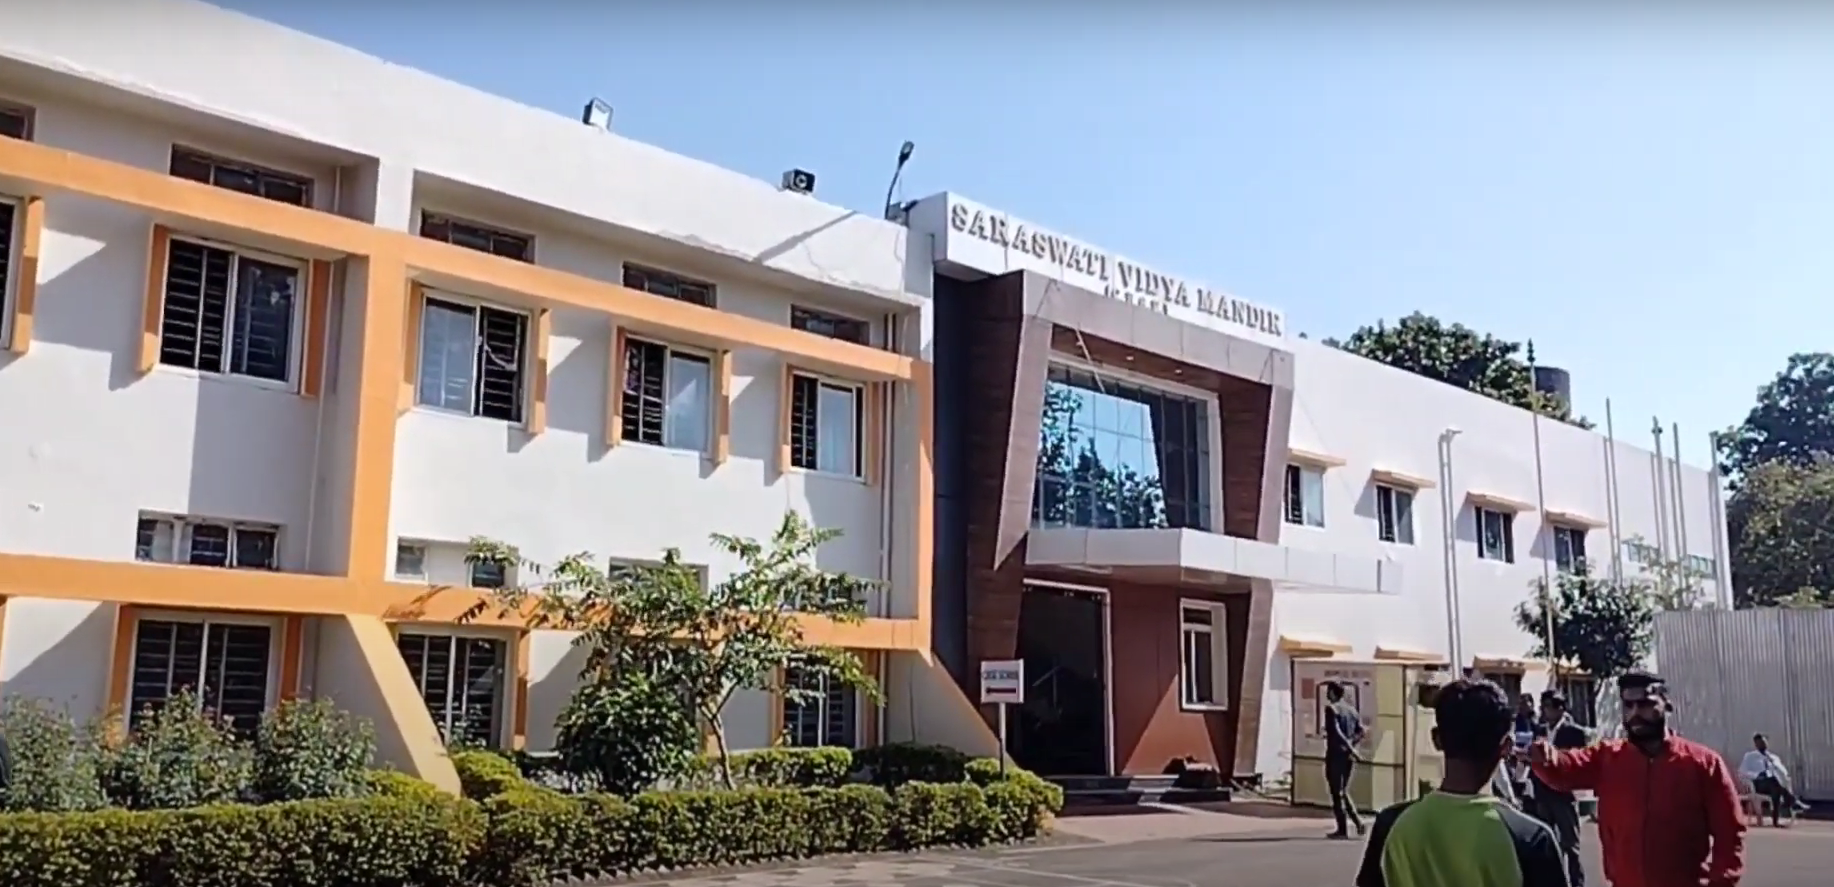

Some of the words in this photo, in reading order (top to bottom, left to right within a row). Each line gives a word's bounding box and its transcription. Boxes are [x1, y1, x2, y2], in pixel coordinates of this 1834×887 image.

[951, 203, 1108, 281] SARASWATI
[1117, 260, 1191, 308] VIDYA
[1196, 287, 1282, 337] MANDIR
